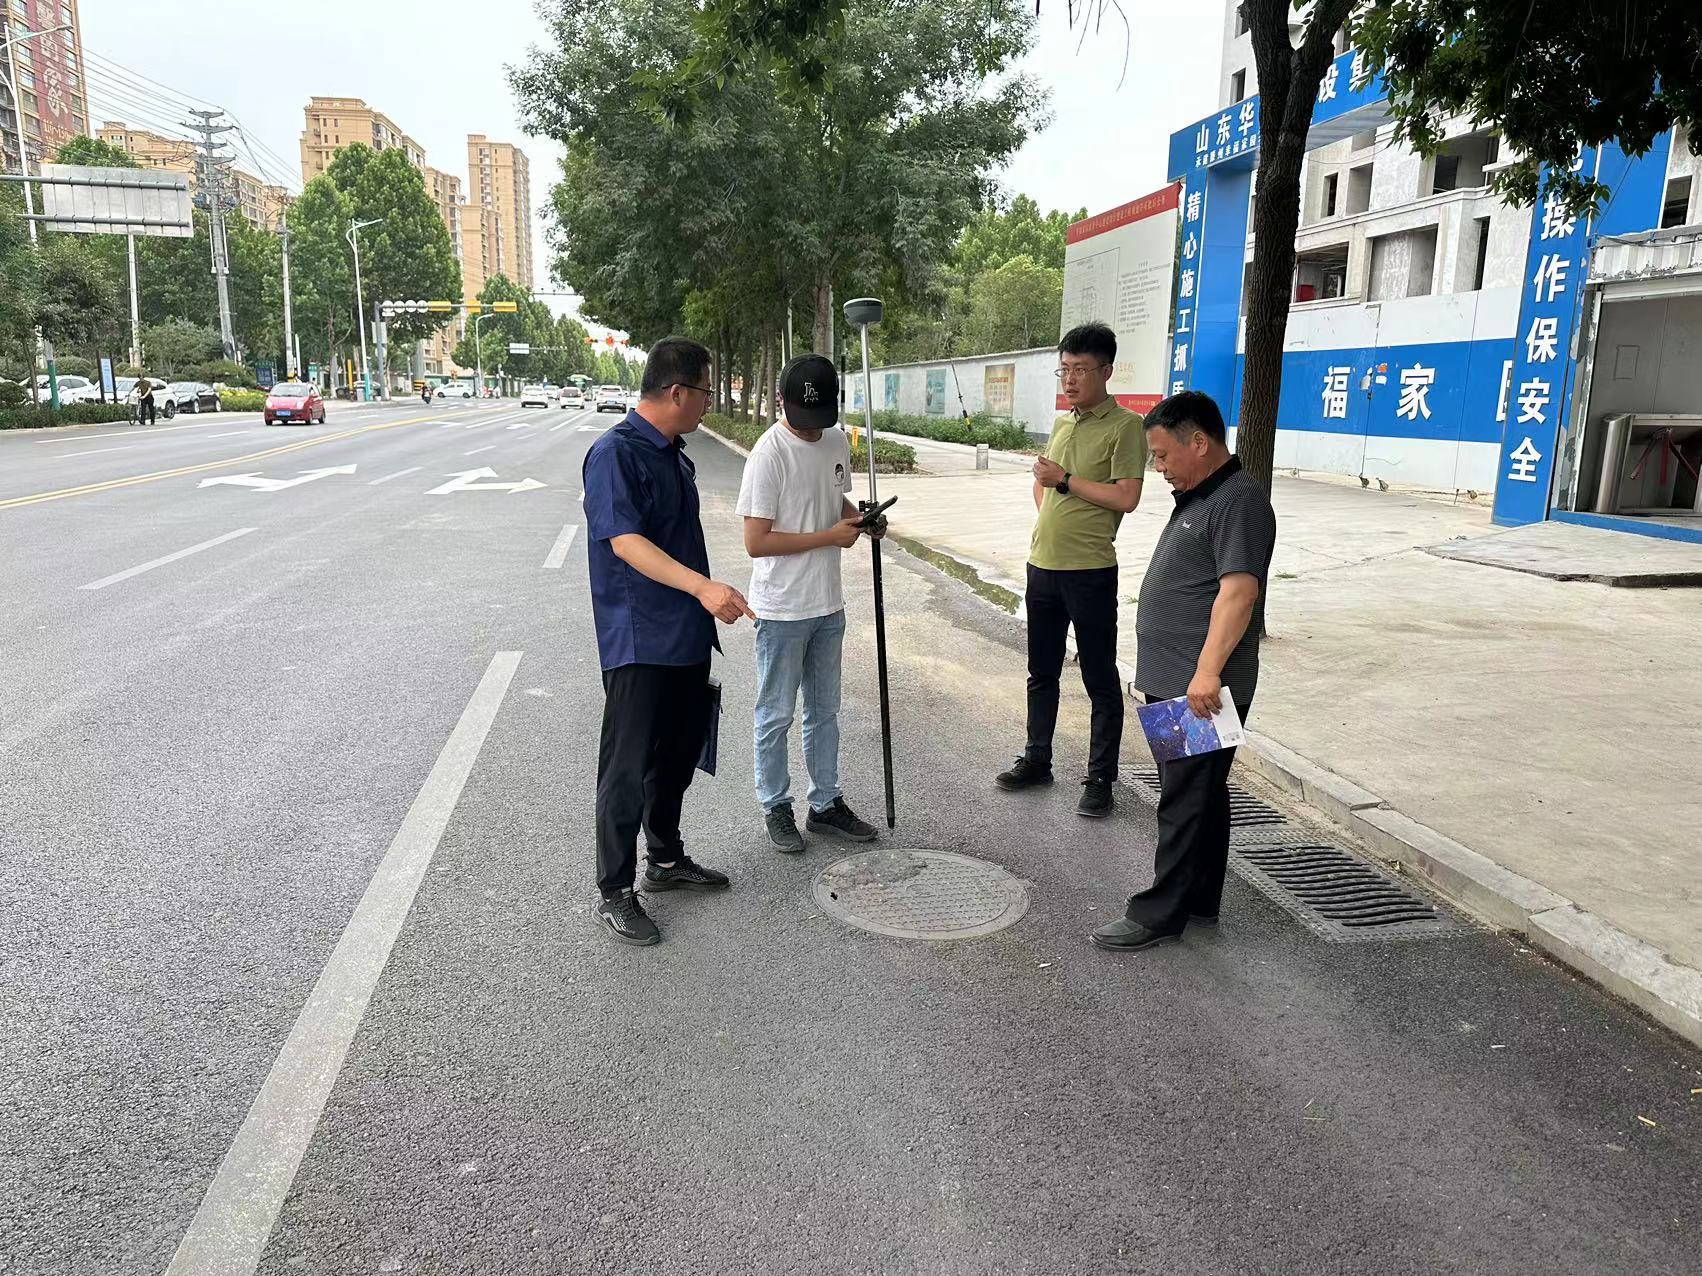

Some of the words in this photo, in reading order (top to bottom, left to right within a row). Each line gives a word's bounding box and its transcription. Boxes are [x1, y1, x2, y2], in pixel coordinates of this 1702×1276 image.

[1508, 140, 1583, 484] 操作保安全
